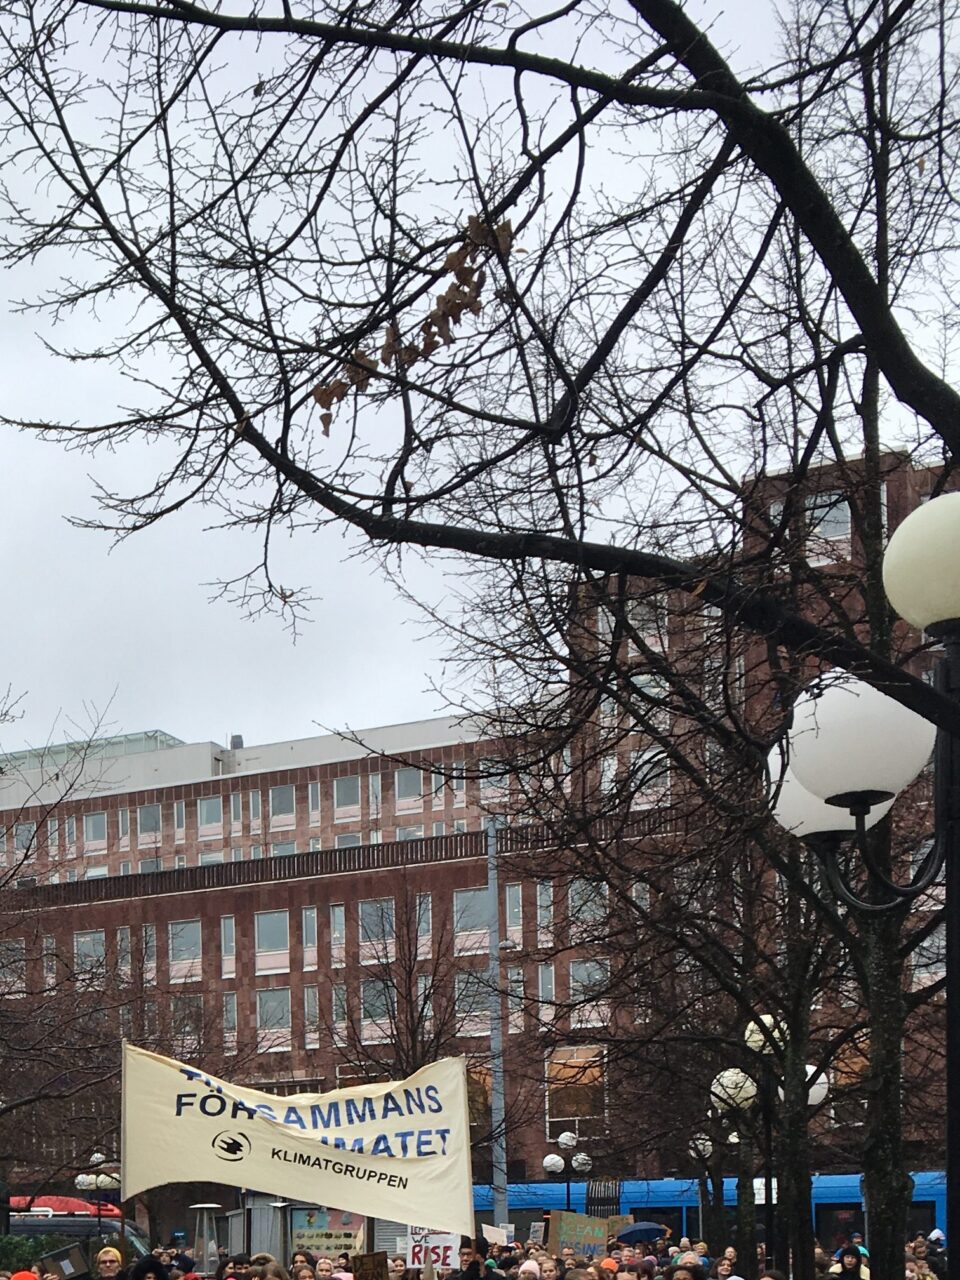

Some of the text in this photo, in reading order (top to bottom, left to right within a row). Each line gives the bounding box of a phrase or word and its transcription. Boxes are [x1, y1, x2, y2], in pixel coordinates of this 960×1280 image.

[271, 1147, 409, 1190] KLIMATGRUPPEN
[411, 1235, 430, 1244] WE
[411, 1244, 453, 1266] RISE
